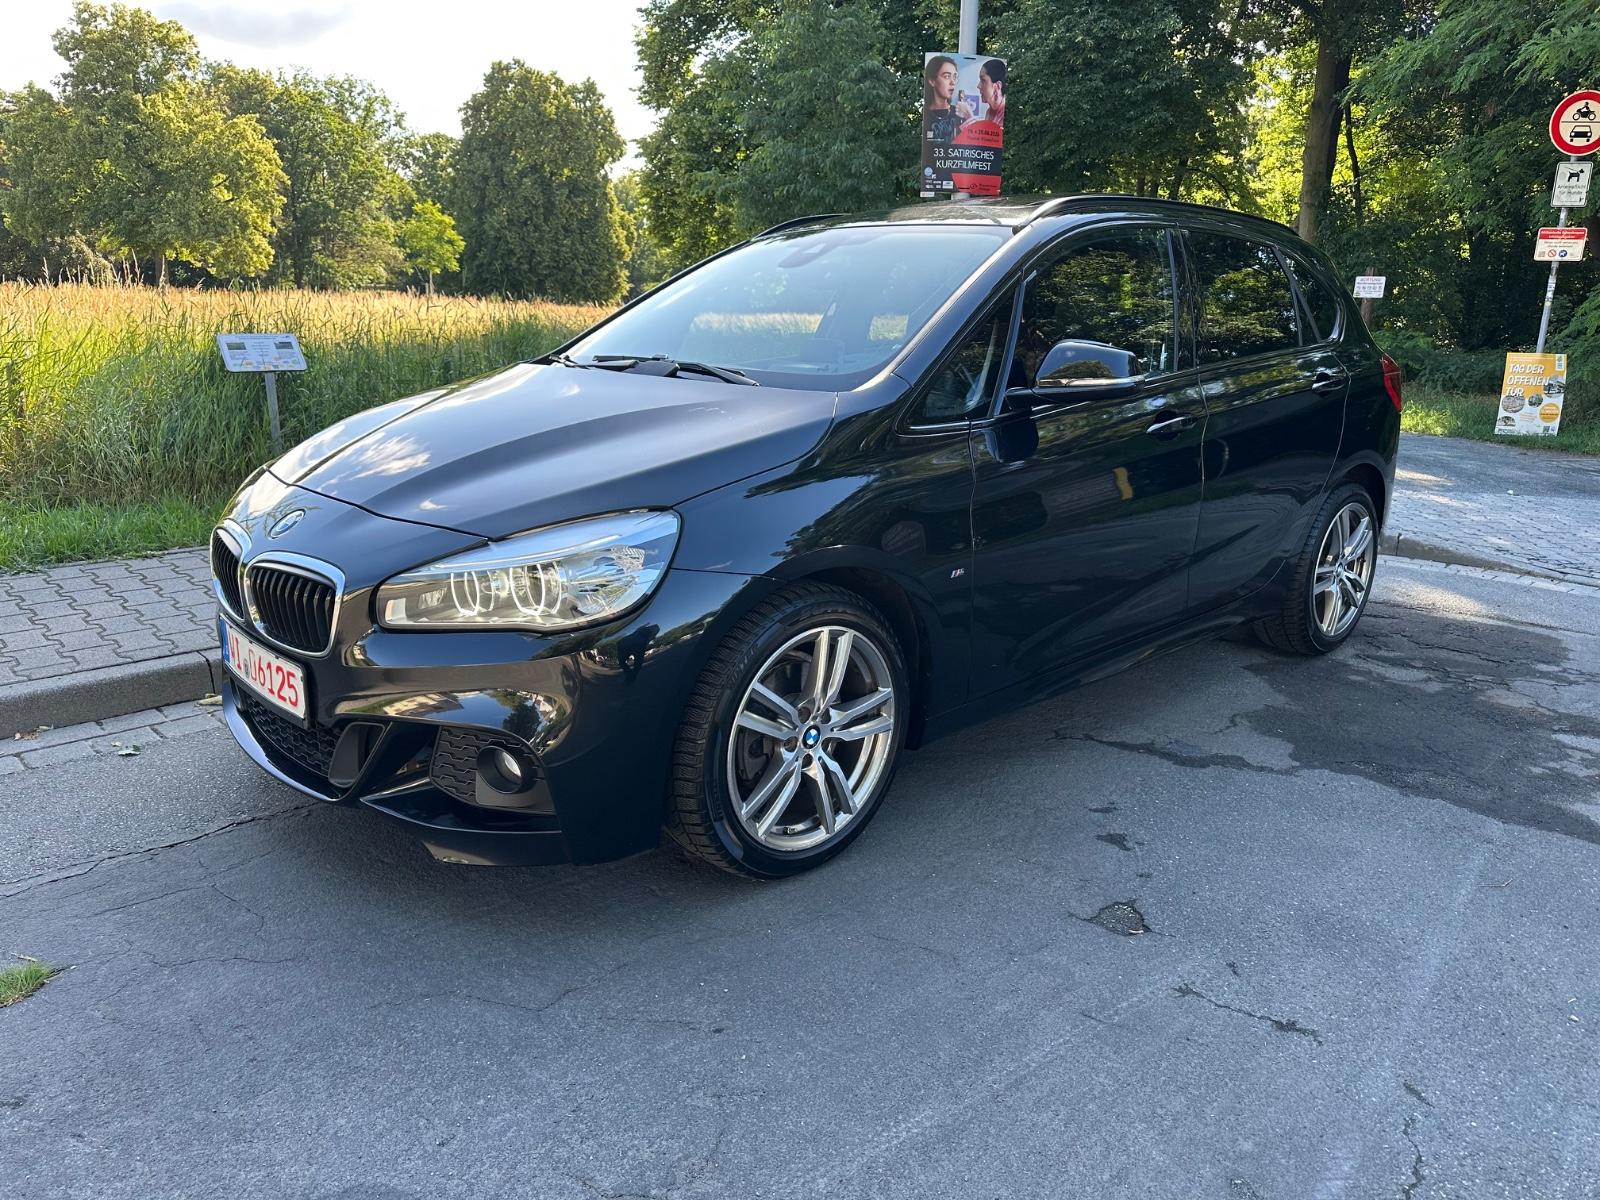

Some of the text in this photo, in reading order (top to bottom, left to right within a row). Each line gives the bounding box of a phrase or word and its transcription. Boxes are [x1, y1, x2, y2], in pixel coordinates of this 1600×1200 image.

[933, 148, 995, 160] 33. SATIRISCHES
[936, 159, 992, 171] KURZFILMFEST
[1510, 364, 1545, 374] TAG DER
[1507, 375, 1549, 386] OFFENEN
